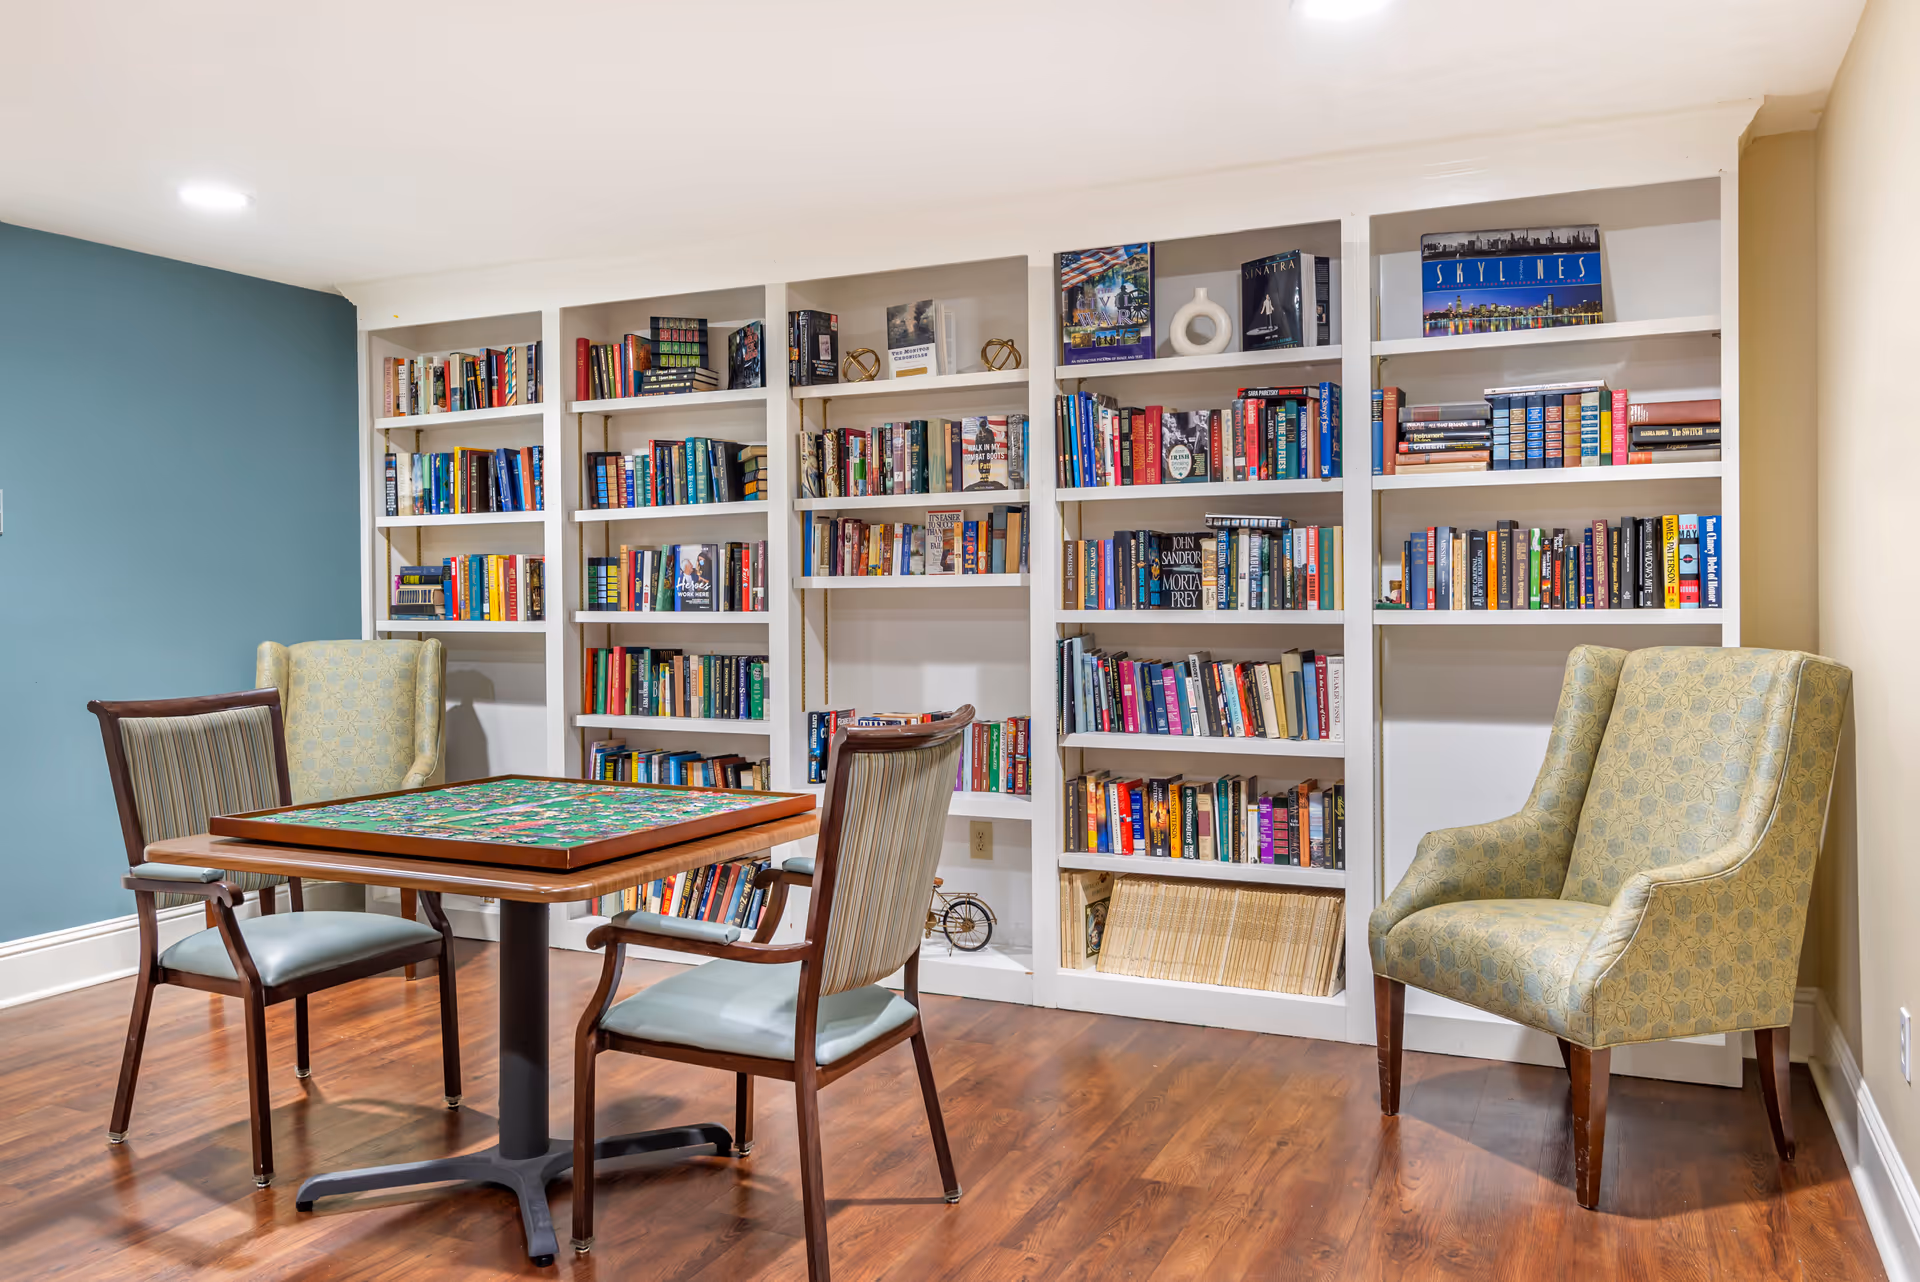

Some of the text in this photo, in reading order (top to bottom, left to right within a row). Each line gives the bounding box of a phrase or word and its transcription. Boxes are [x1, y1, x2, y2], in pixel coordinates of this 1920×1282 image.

[1245, 259, 1295, 279] SINATRA
[1077, 309, 1136, 327] WAR
[1279, 413, 1285, 421] AS
[1682, 428, 1703, 436] SWITCH
[1146, 441, 1155, 463] Passage
[1679, 530, 1698, 539] MAY
[1704, 517, 1717, 555] Tom Clancy
[1173, 537, 1194, 551] JOHN
[1218, 531, 1226, 568] FAYE KELLERMAN
[1665, 518, 1675, 583] JAMES PATTERSON
[1162, 551, 1202, 564] SANDFOR
[1707, 556, 1718, 573] Debt
[675, 578, 711, 590] Heroes
[1162, 574, 1202, 590] MORTA
[1218, 574, 1226, 603] FORGOTTEN
[1516, 563, 1525, 606] Elizabeth George
[1171, 591, 1199, 607] PREY
[1478, 588, 1483, 596] OF
[1708, 581, 1718, 602] Honor
[738, 896, 748, 912] ZERO
